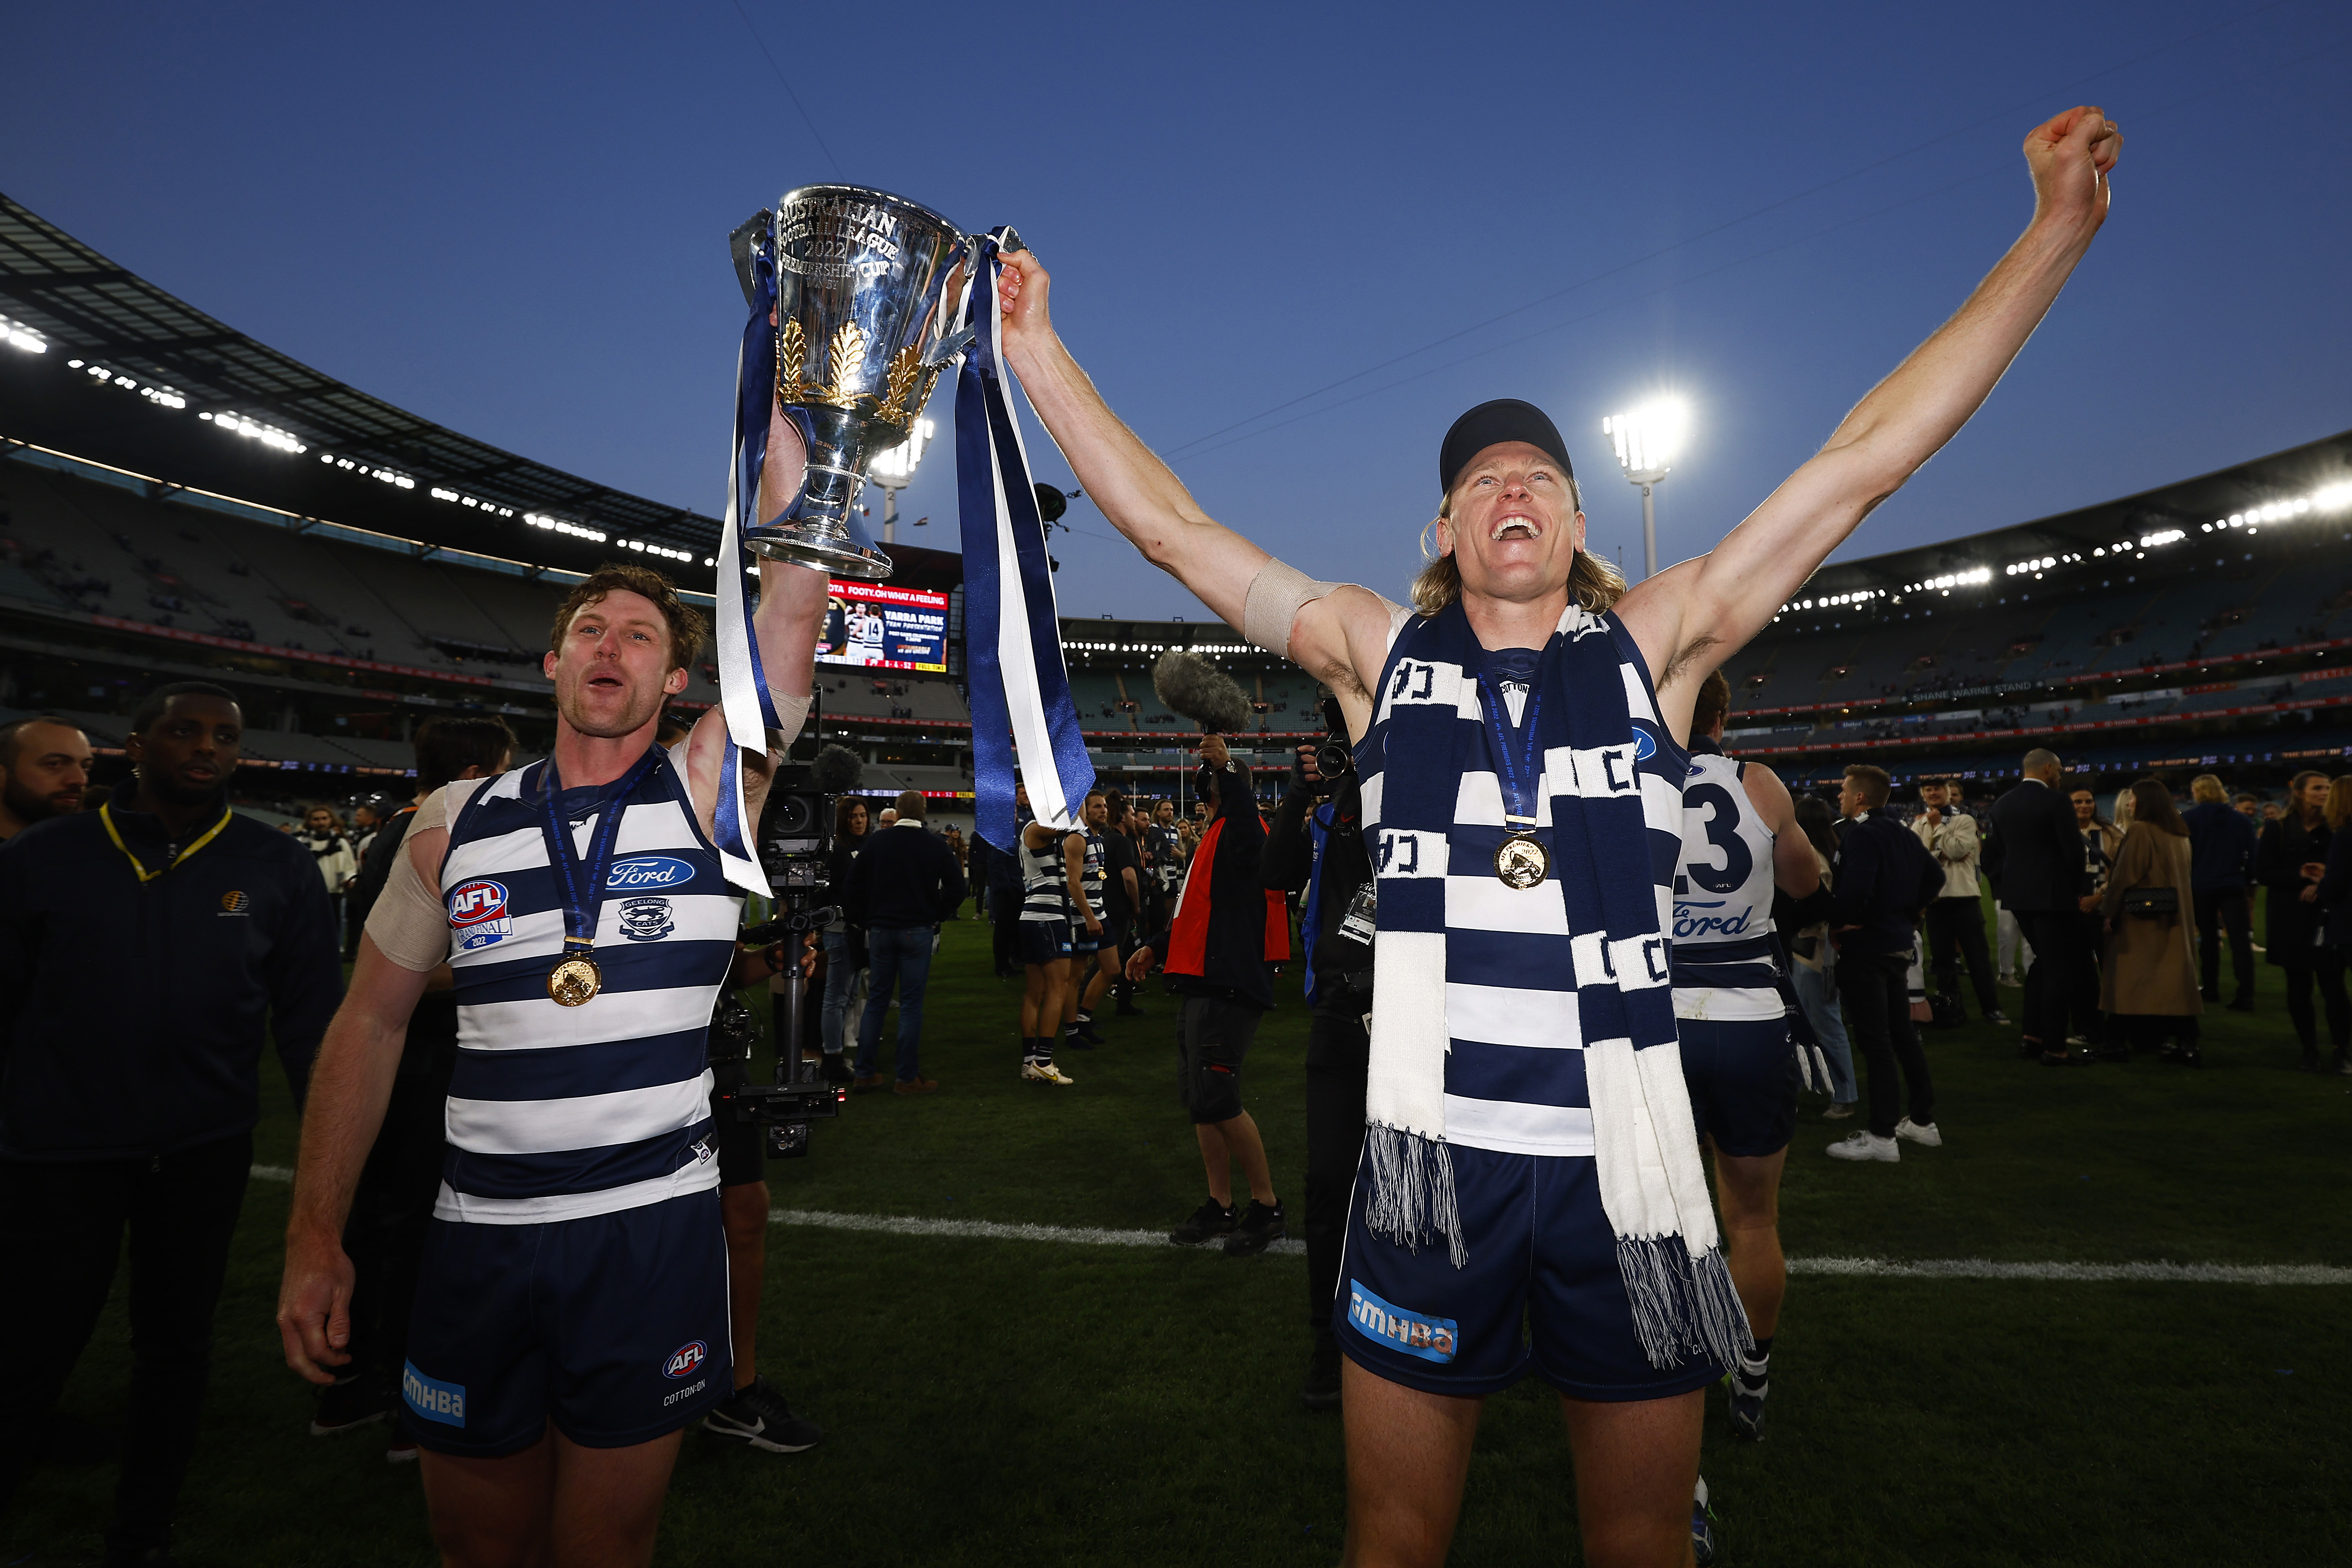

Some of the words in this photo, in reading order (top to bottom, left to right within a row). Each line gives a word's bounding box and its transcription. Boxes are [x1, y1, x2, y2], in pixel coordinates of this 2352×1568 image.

[782, 195, 897, 238] AUSTRALIAN
[805, 241, 845, 259] 2022
[837, 222, 899, 261] LEAGUE
[782, 252, 855, 277] PREMIERSHIP
[860, 260, 890, 278] CUP
[887, 591, 910, 601] WHAT
[916, 595, 945, 605] FEELING
[884, 610, 917, 623] YARRA
[918, 614, 944, 626] PARK
[1913, 690, 1949, 702] SHANE
[1951, 686, 1991, 697] WARNE
[1994, 681, 2032, 694] STAND
[1528, 717, 1538, 741] PREMIERS
[1500, 741, 1512, 766] PREMIERS
[597, 837, 607, 861] PREMIERS
[1674, 783, 1753, 895] 3
[606, 862, 676, 886] Ford
[453, 888, 501, 915] AFL
[625, 899, 665, 907] GEELONG
[476, 920, 509, 933] FINAL
[472, 936, 487, 947] 2022
[667, 1345, 704, 1375] AFL
[663, 1378, 706, 1407] COTTON:ON
